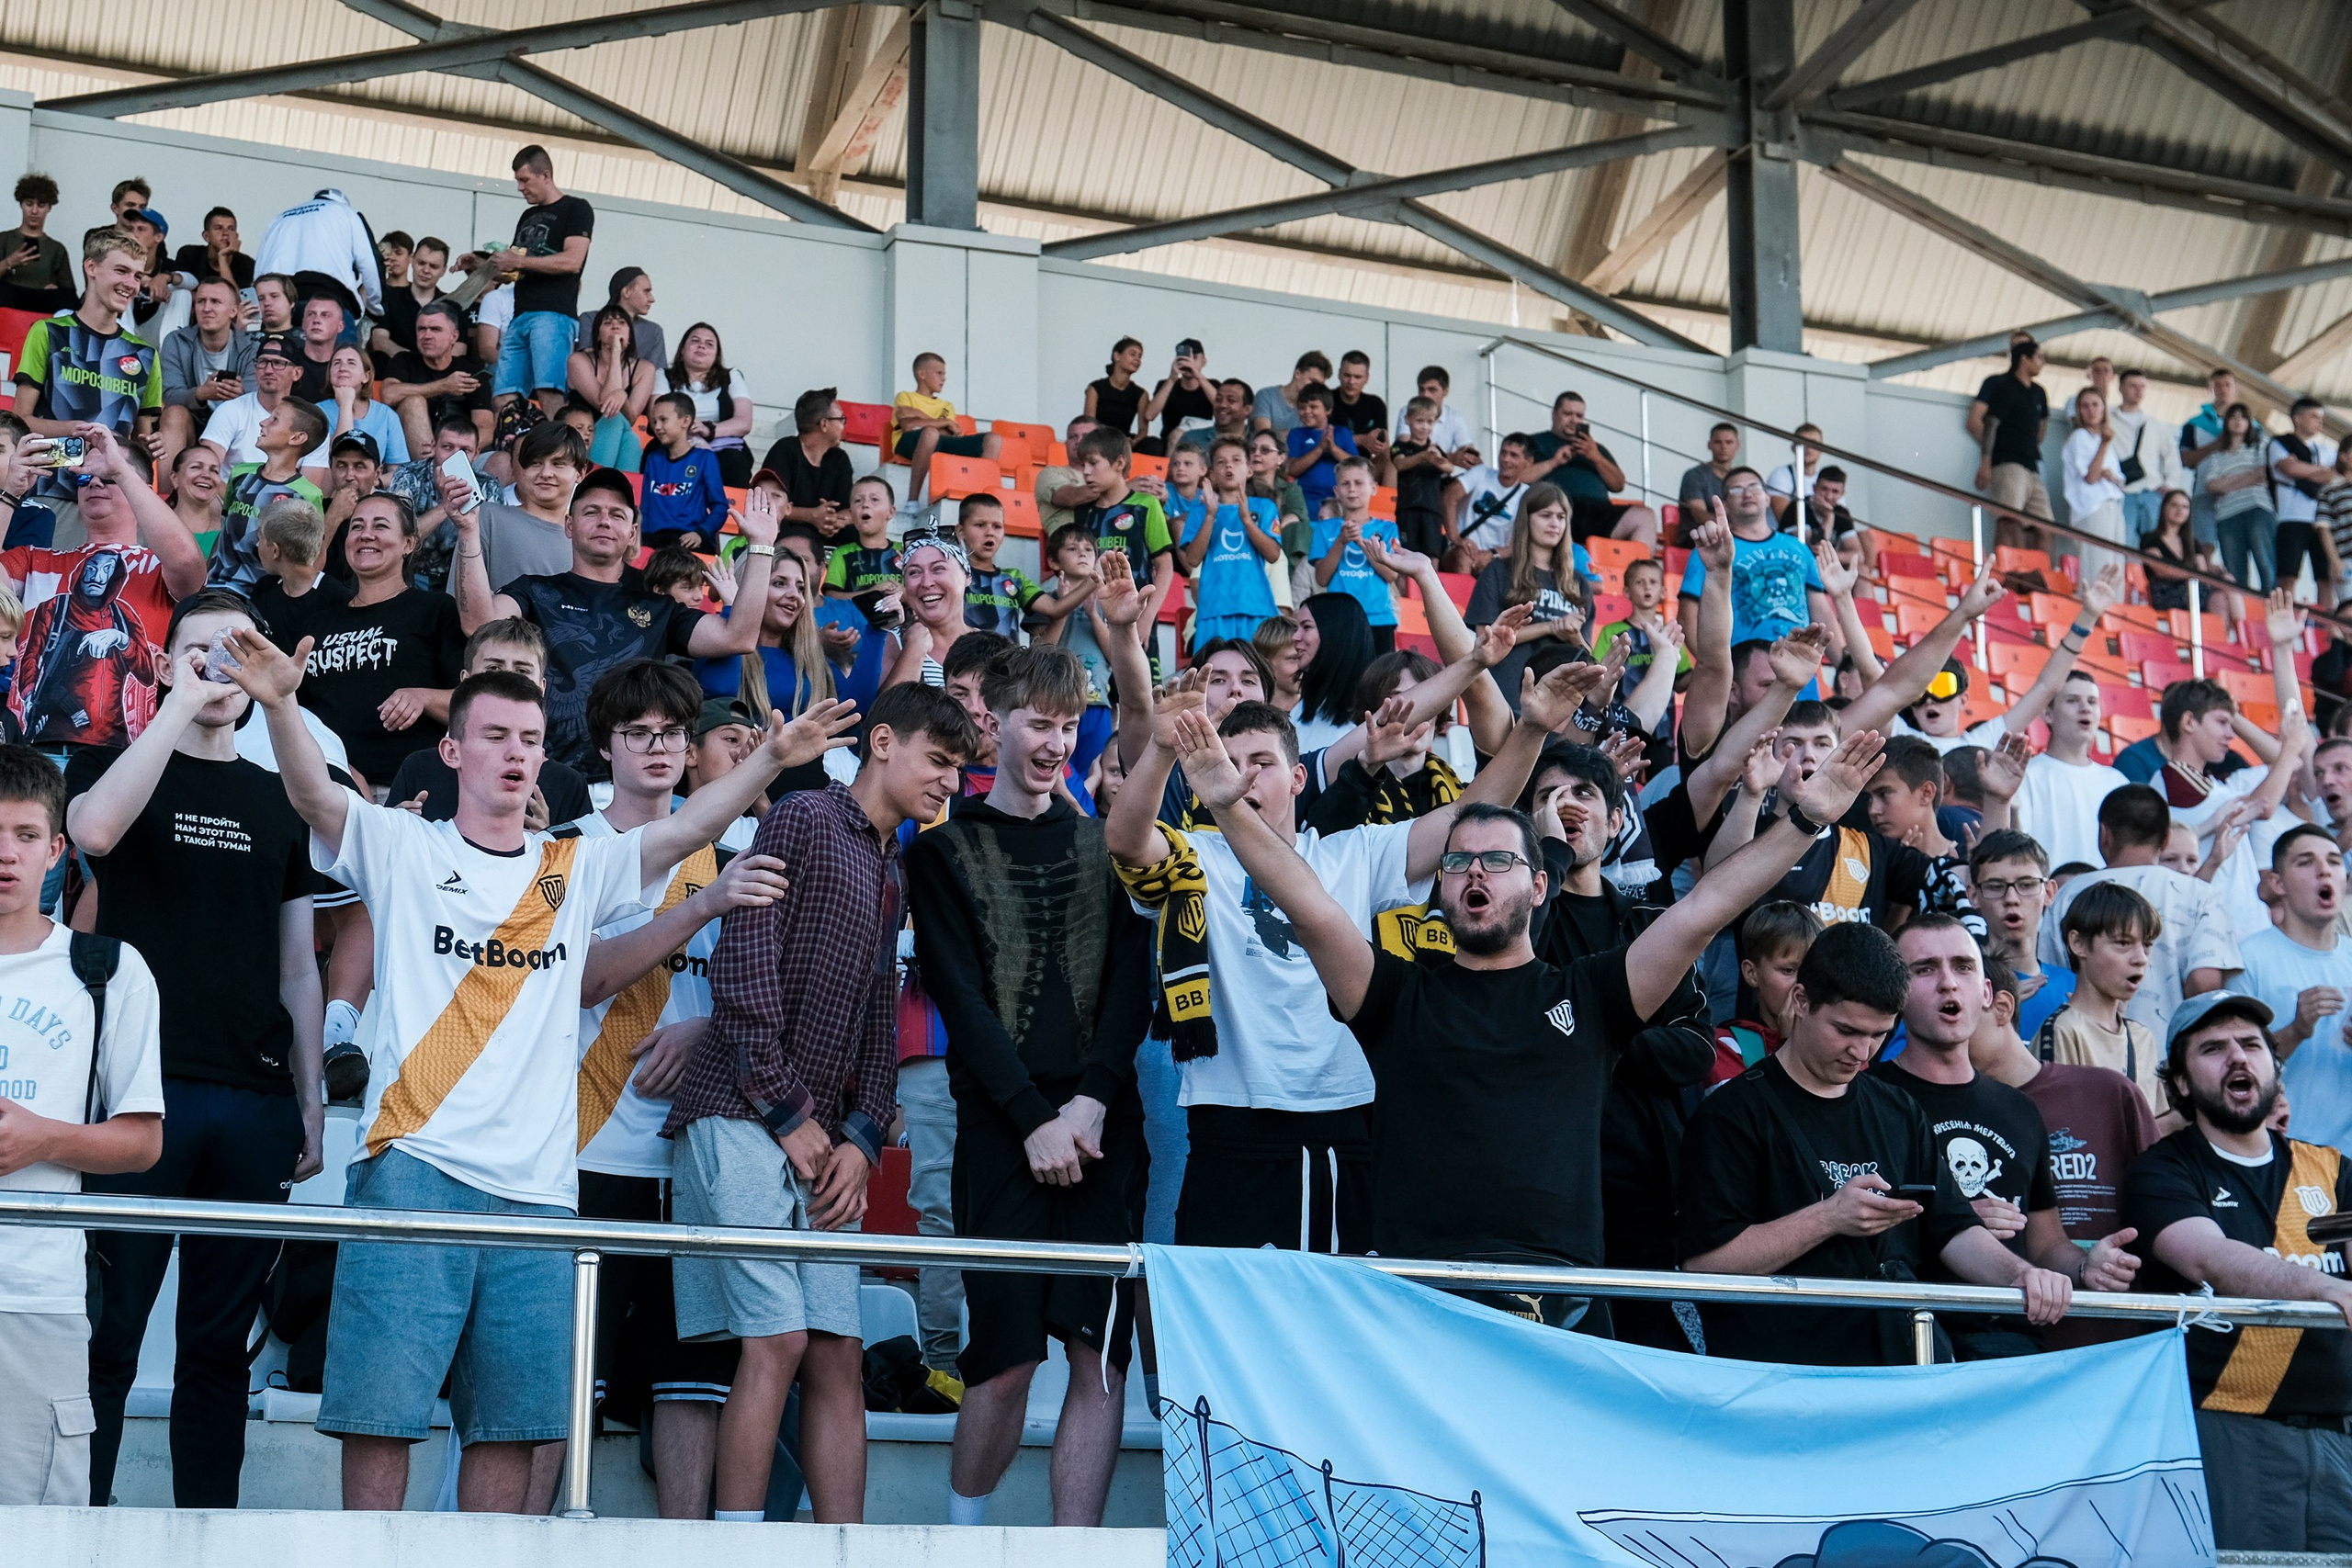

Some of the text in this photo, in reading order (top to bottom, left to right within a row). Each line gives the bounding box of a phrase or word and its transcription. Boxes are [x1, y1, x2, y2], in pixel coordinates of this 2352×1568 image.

[61, 365, 138, 397] МОРОЗОВЕЦ
[322, 626, 383, 649] USUAL
[307, 637, 398, 677] SUSPECT
[175, 812, 240, 829] И НЕ ПРОЙТИ
[175, 823, 252, 841] НАМ ЭТОТ ПУТЬ
[183, 834, 215, 847] ТАКОЙ
[217, 840, 251, 852] ТУМАН
[435, 884, 469, 896] DEMIX
[434, 924, 567, 970] BetBoom
[7, 998, 72, 1051] DAYS
